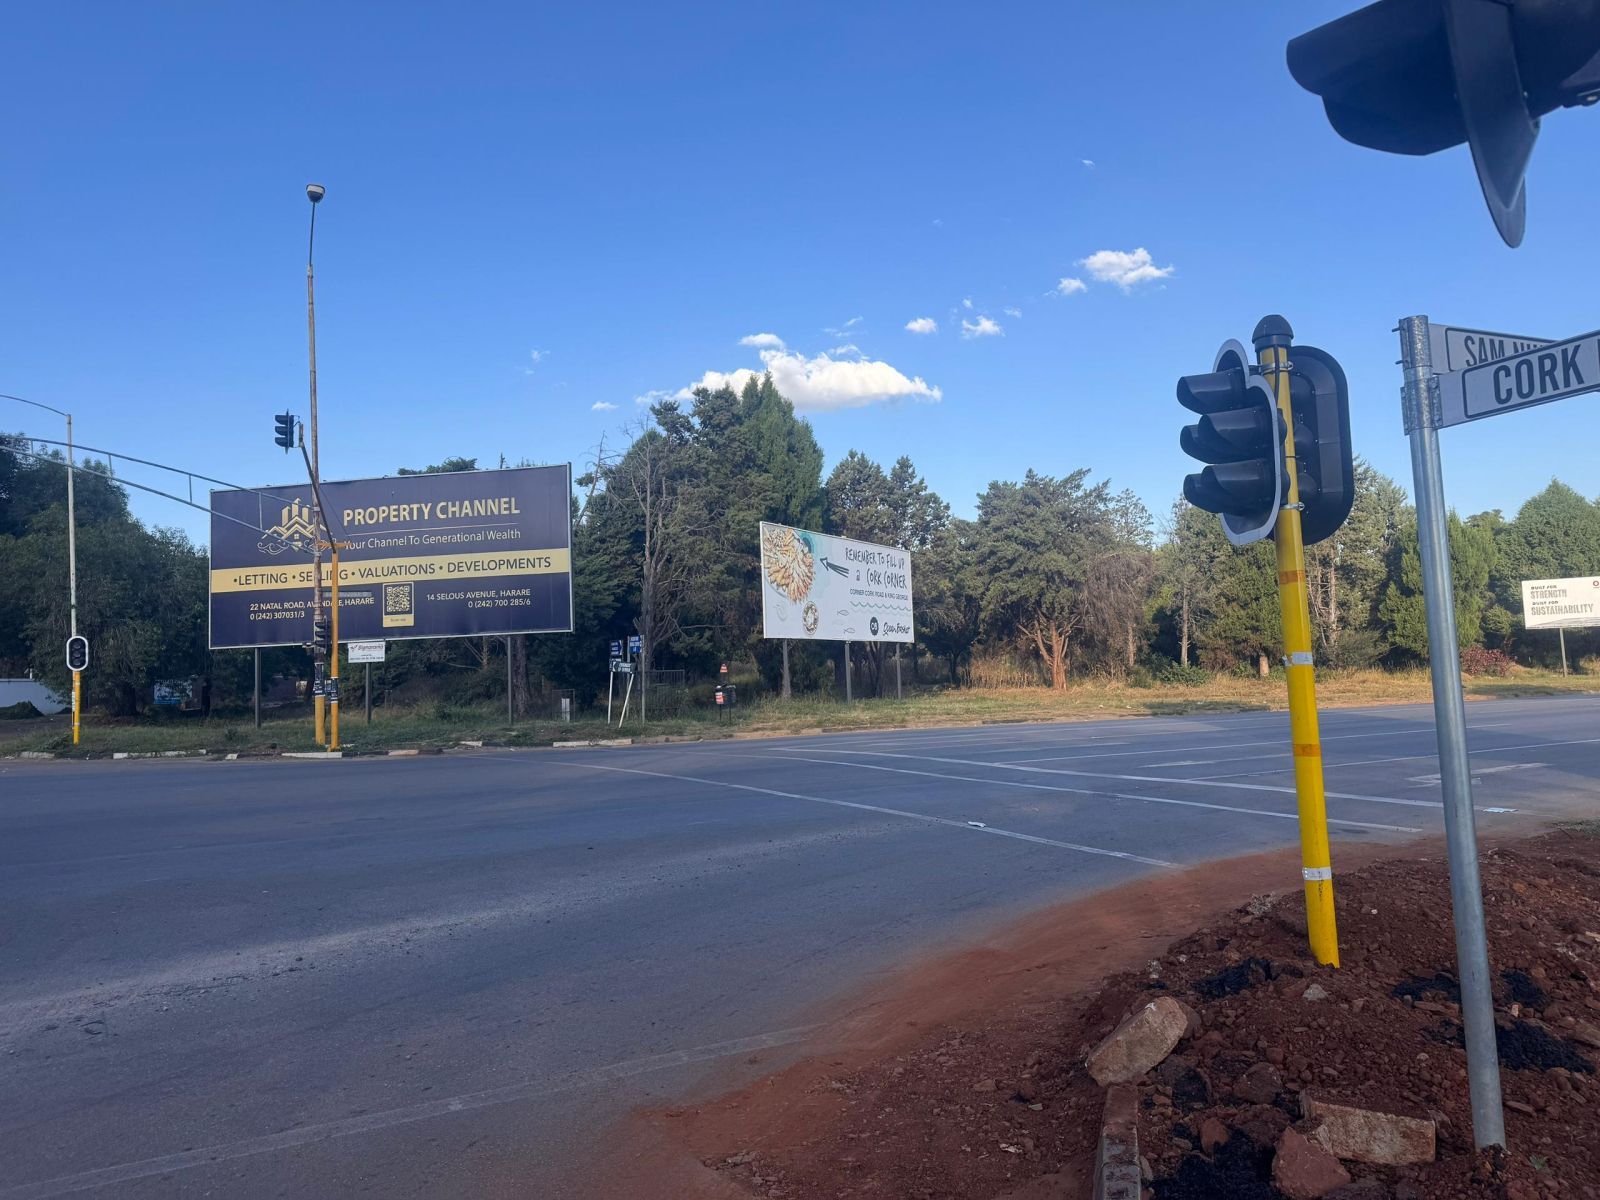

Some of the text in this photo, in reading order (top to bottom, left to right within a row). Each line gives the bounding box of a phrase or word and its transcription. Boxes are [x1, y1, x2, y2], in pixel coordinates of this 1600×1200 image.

[1464, 335, 1506, 367] SAM
[1493, 344, 1584, 405] CORK
[343, 497, 521, 526] PROPERTY CHANNEL
[344, 529, 521, 550] Your Channel To Generational Wealth
[845, 547, 876, 565] REMEMBER
[238, 572, 288, 586] LETTING
[358, 563, 436, 579] VALUATIONS
[447, 556, 551, 573] DEVELOPMENTS
[867, 568, 882, 587] CORK
[884, 570, 908, 589] CORNER
[436, 591, 465, 600] SELOUS
[466, 590, 498, 599] AVENUE,
[500, 588, 531, 597] HARARE
[1530, 589, 1567, 599] STRENGTH
[250, 603, 259, 611] 22
[260, 602, 283, 610] NATAL
[283, 601, 306, 609] ROAD,
[345, 597, 375, 606] HARARE
[474, 599, 493, 609] (242)
[494, 599, 508, 607] 700
[510, 598, 531, 606] 285/6
[1531, 603, 1593, 616] SUSTAINABILITY
[255, 612, 273, 621] (242)
[273, 610, 305, 619] 307031/3
